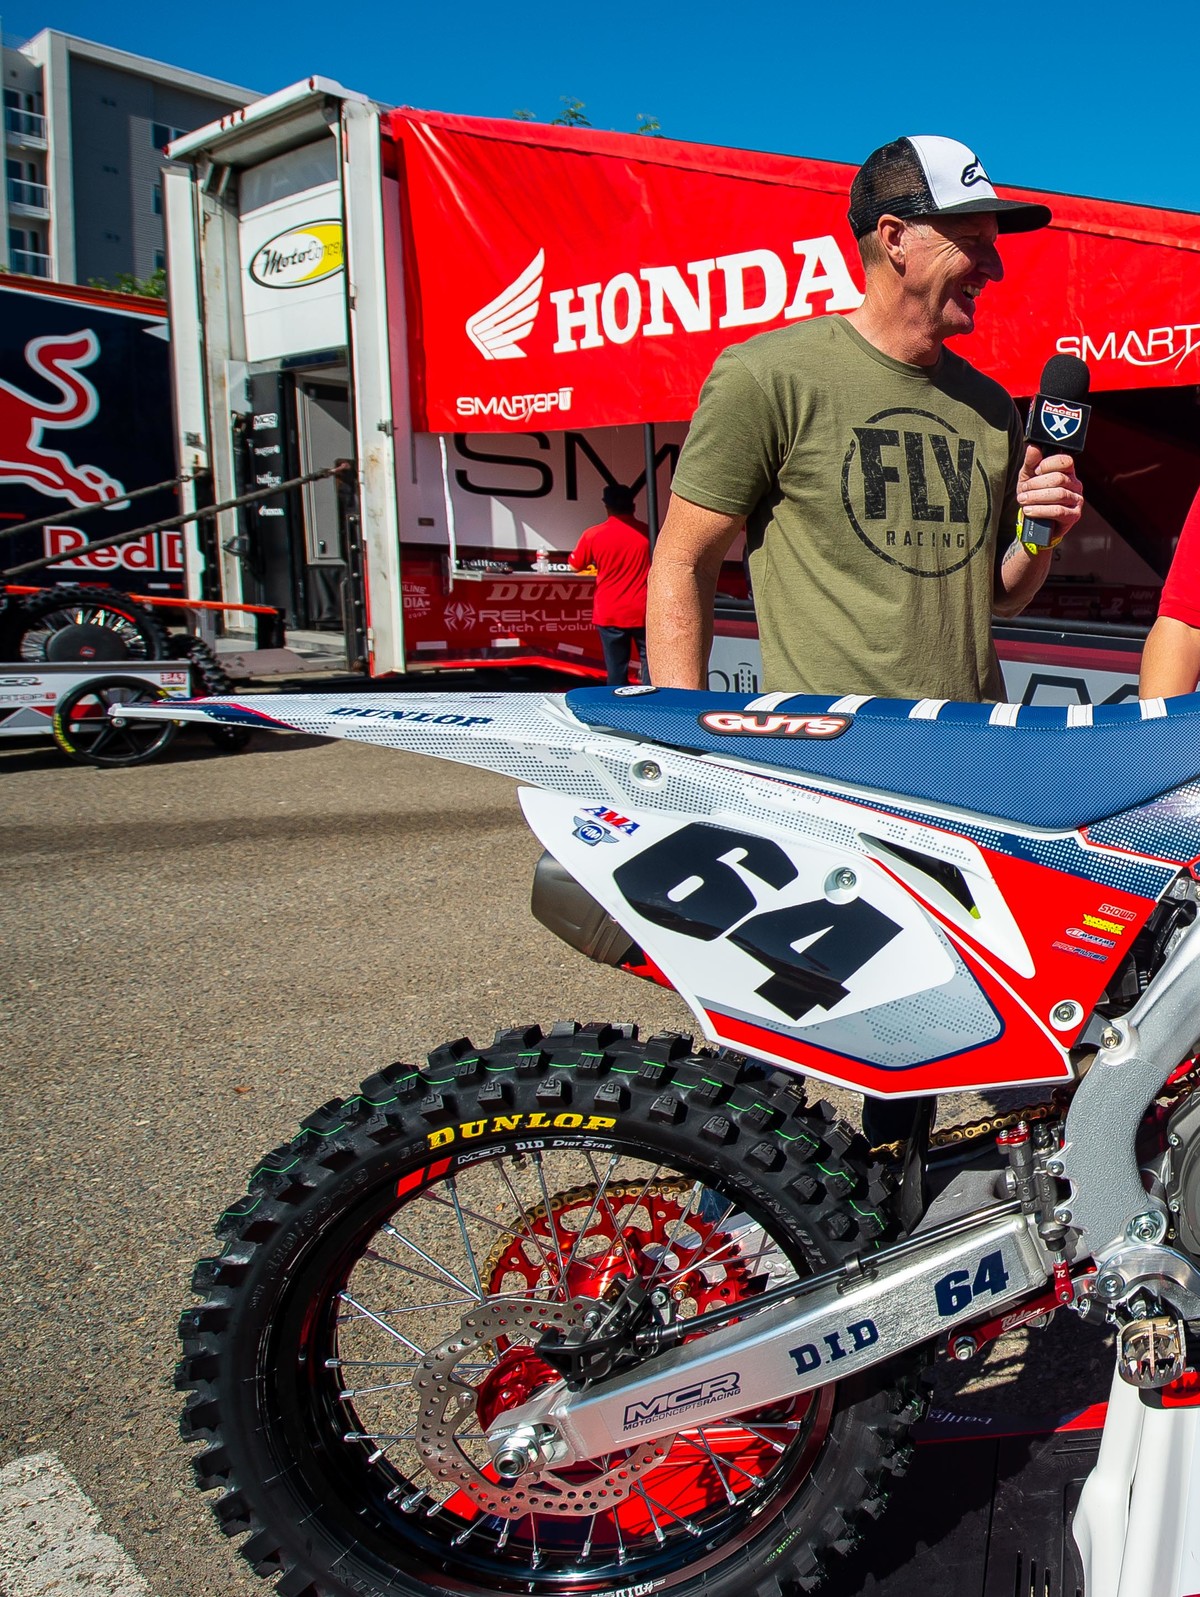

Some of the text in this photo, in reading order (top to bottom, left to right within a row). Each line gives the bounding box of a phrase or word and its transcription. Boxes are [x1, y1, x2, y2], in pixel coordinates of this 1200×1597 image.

[550, 235, 866, 354] HONDA
[456, 391, 560, 423] SMARTOP
[1045, 406, 1080, 418] RACER
[1049, 415, 1069, 435] X
[852, 427, 975, 523] FLY
[44, 526, 160, 571] Red
[886, 531, 965, 548] RACING
[328, 706, 494, 727] DUNLOP
[704, 713, 850, 734] GUTS
[580, 806, 640, 836] AMA
[582, 827, 601, 841] FIM
[611, 821, 904, 1021] 64
[1099, 904, 1136, 920] SHOWA
[427, 1113, 616, 1150] DUNLOP
[457, 1146, 507, 1165] MCR
[934, 1251, 1009, 1316] 64
[623, 1371, 741, 1422] MCR
